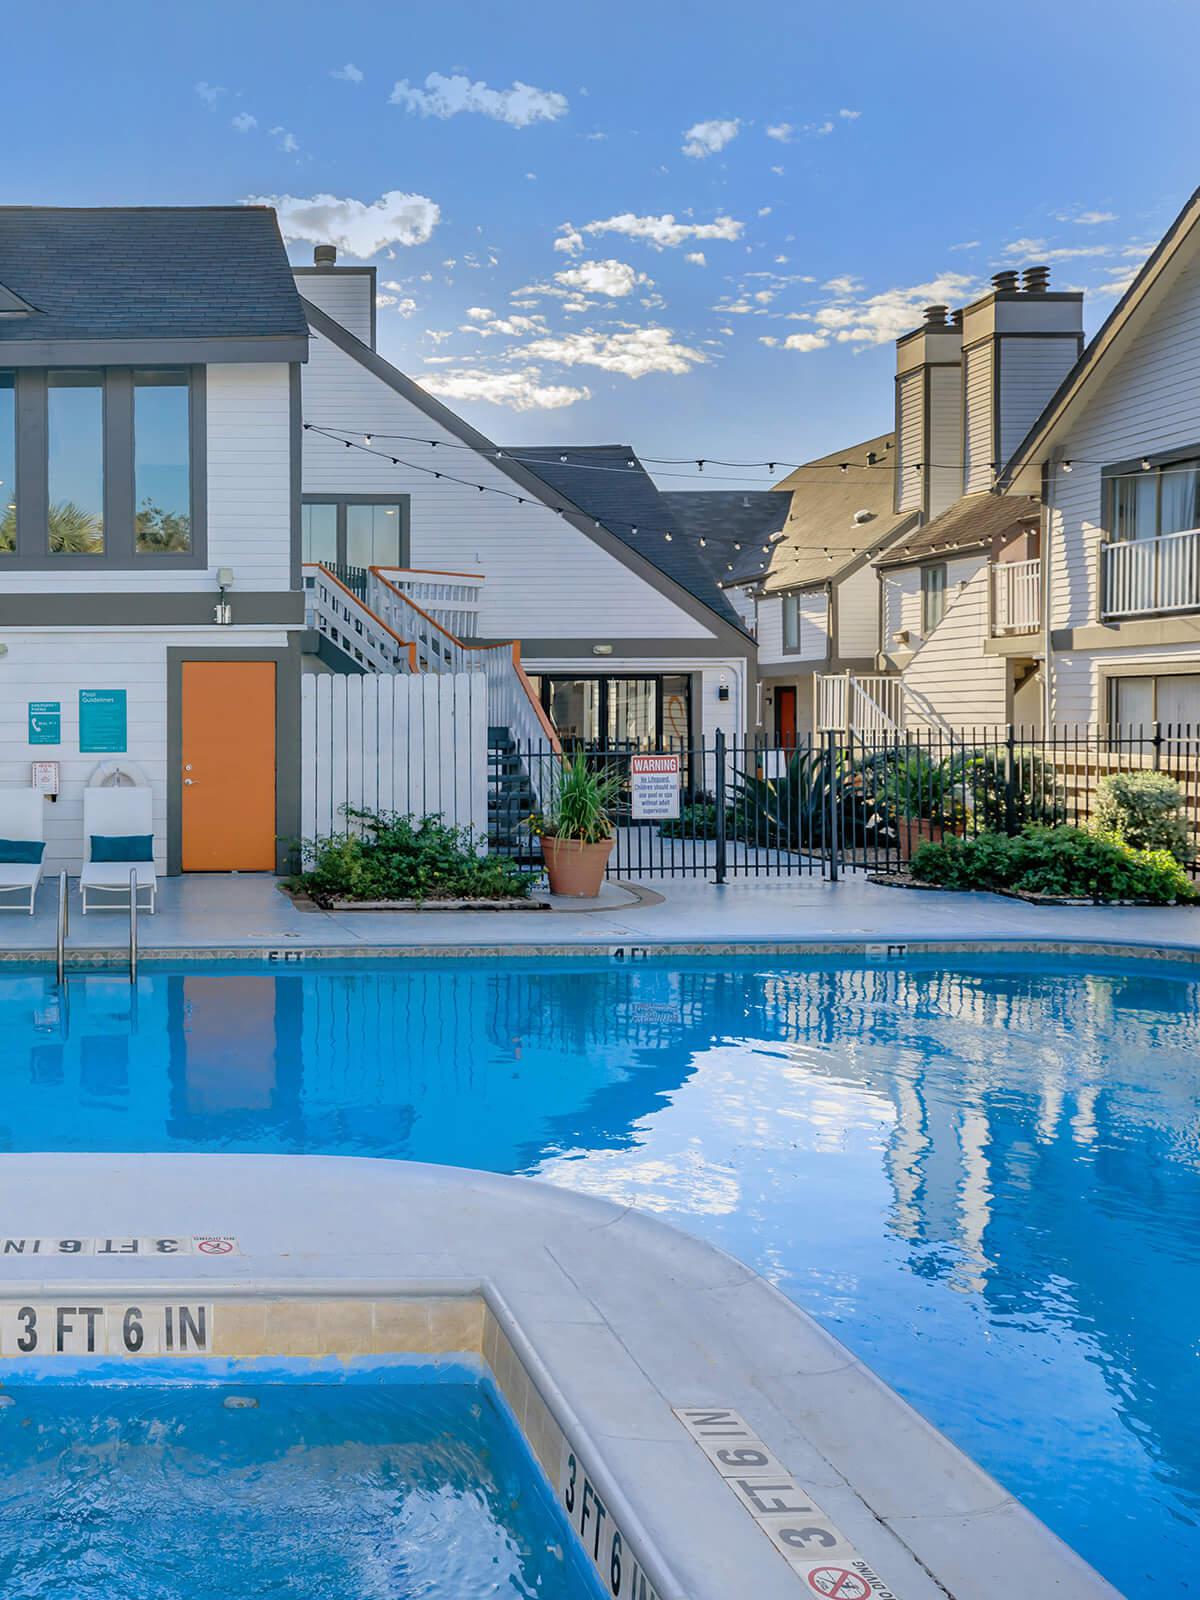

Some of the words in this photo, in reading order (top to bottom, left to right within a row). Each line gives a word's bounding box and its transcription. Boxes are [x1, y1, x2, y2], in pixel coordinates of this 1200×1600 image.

[634, 759, 677, 771] WARNING
[3, 1240, 40, 1254] IN
[58, 1240, 82, 1254] 6
[98, 1240, 139, 1254] FT
[156, 1240, 179, 1254] 3
[17, 1306, 38, 1353] 3
[56, 1307, 103, 1353] FT
[123, 1306, 144, 1353] 6
[164, 1306, 206, 1351] IN
[684, 1411, 747, 1437] IN
[716, 1448, 769, 1467] 6
[742, 1480, 813, 1515] FT
[565, 1453, 576, 1513] 3
[581, 1477, 606, 1561] FT
[611, 1531, 622, 1597] 6
[778, 1527, 837, 1550] 3
[852, 1561, 887, 1590] DIVING
